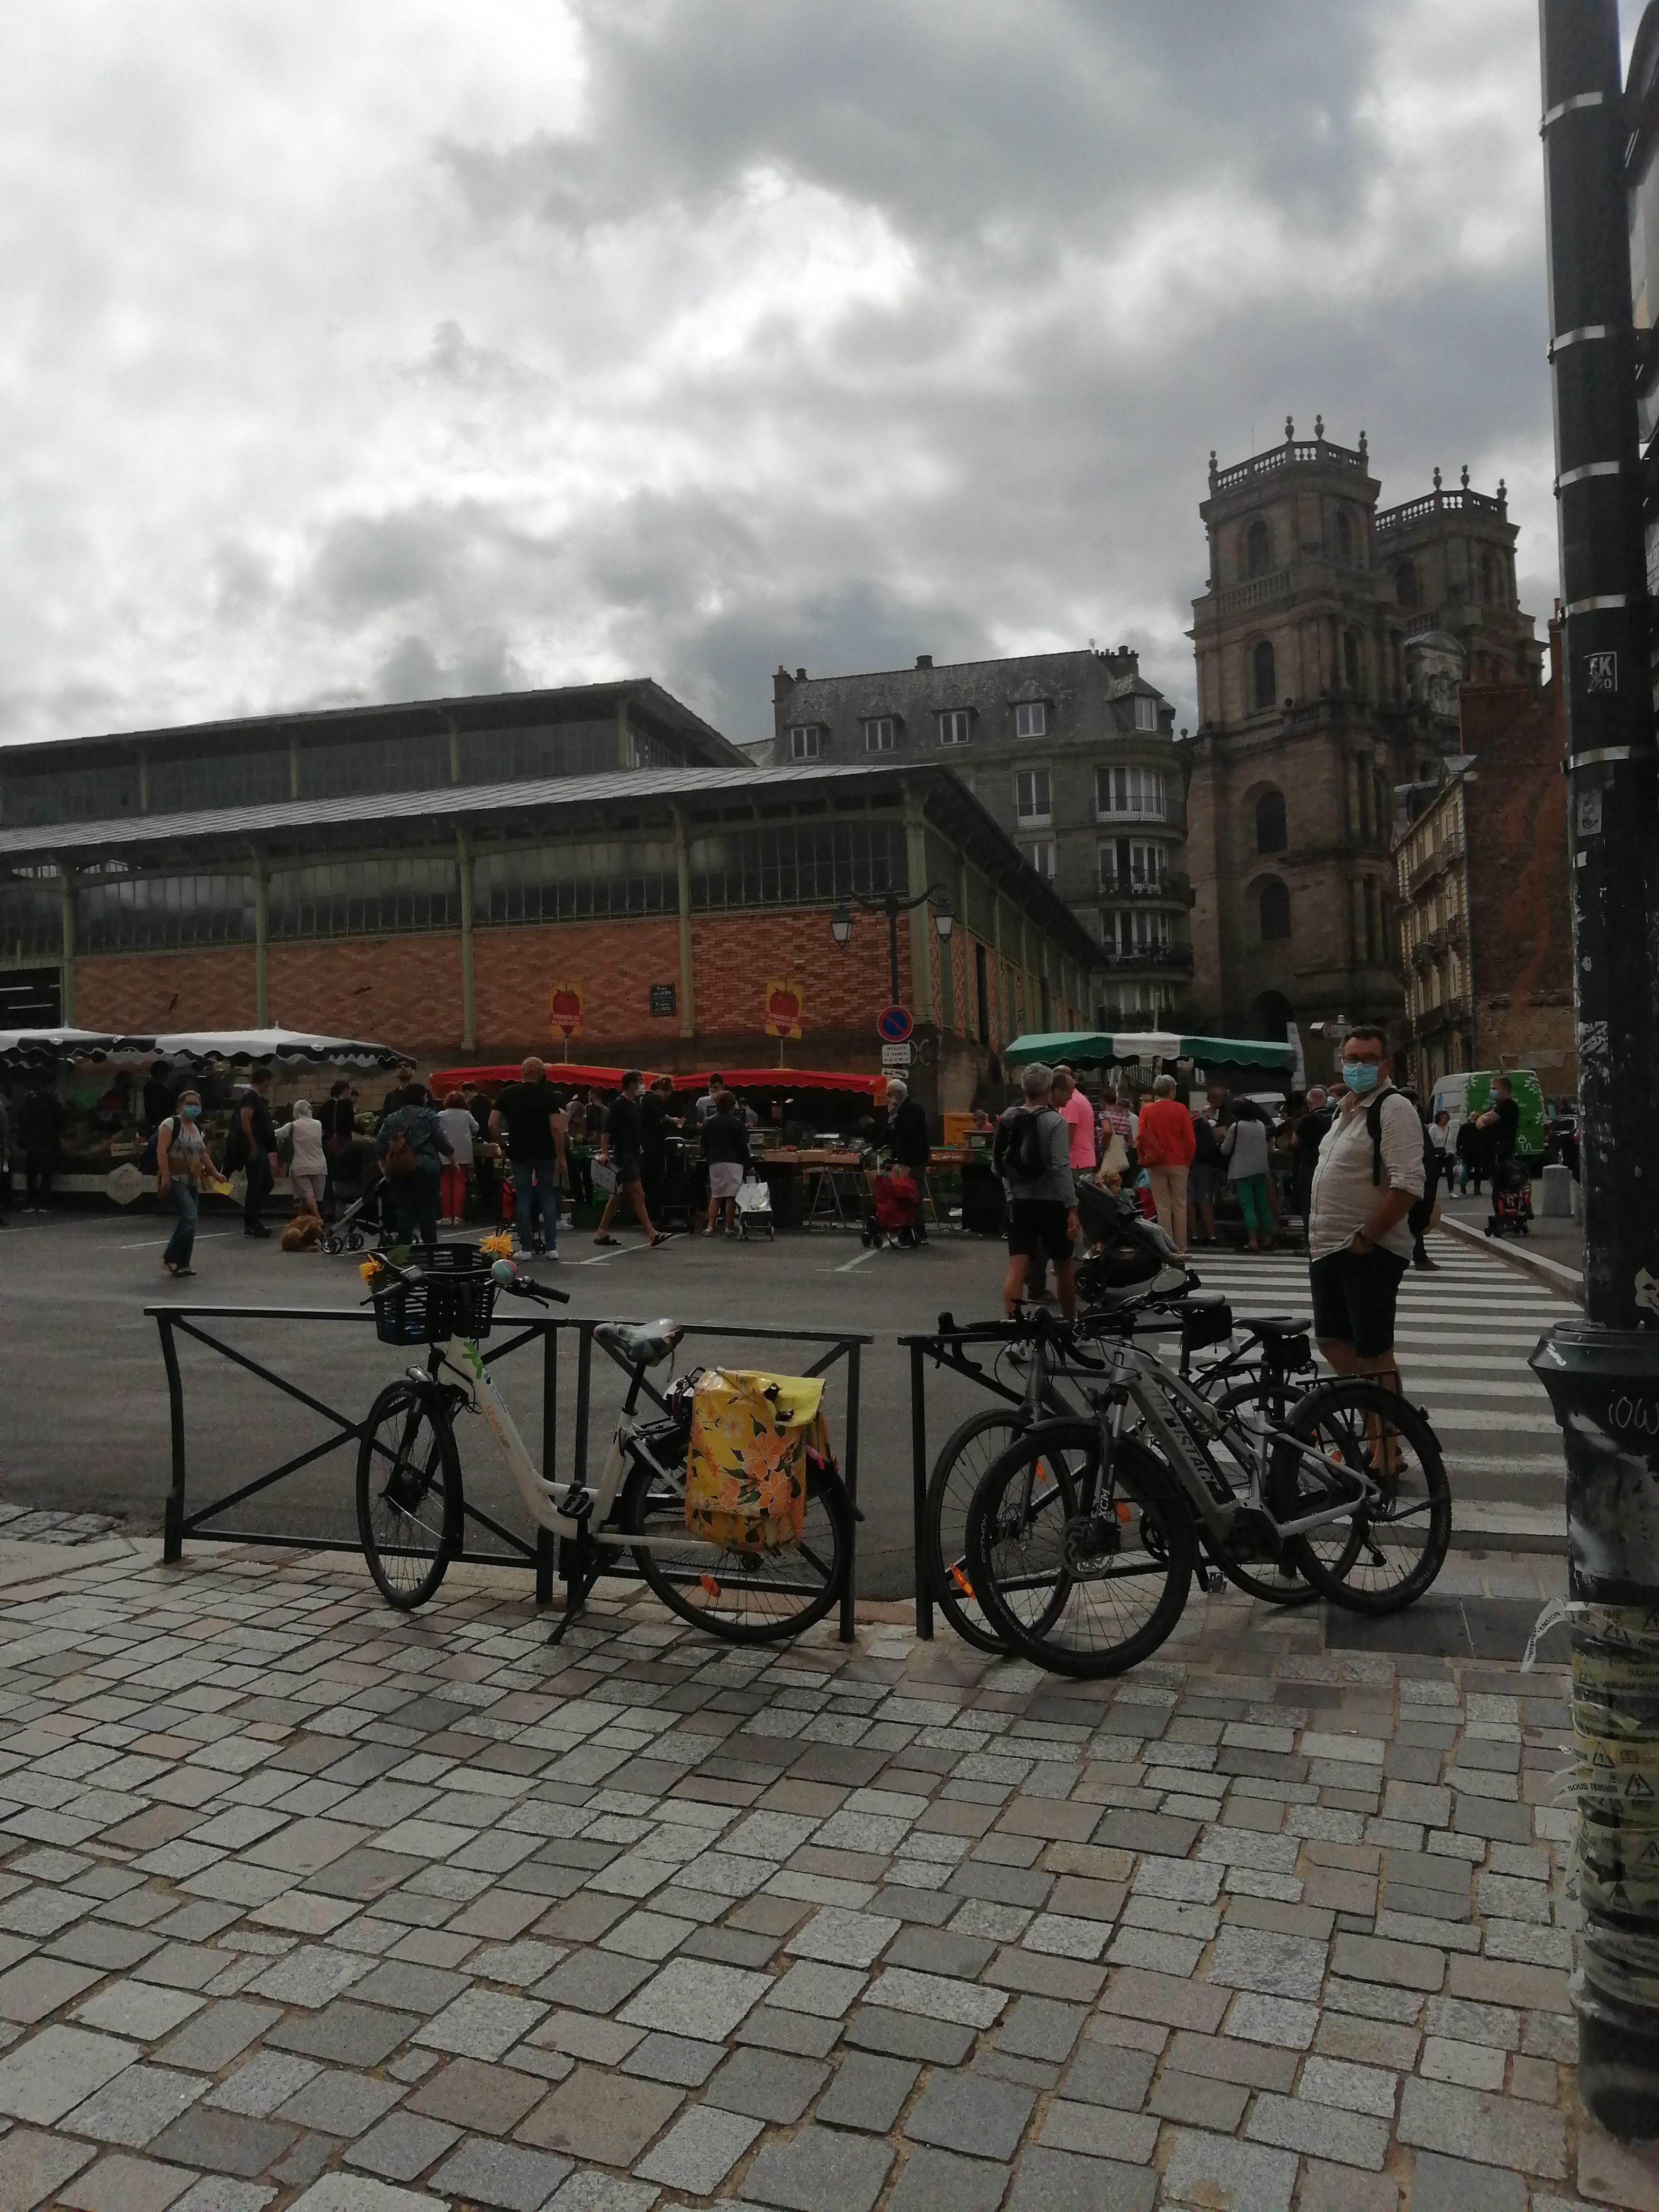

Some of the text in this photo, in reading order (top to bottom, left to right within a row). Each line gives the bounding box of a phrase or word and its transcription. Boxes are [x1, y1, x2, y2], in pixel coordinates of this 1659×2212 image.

[769, 1013, 791, 1022] FRAISES
[1098, 1487, 1109, 1521] XCM
[987, 1582, 1029, 1641] HUTCHINSON
[1537, 1611, 1561, 1633] ENSION
[1567, 1782, 1589, 1792] SOUS
[1589, 1782, 1618, 1793] TENSION
